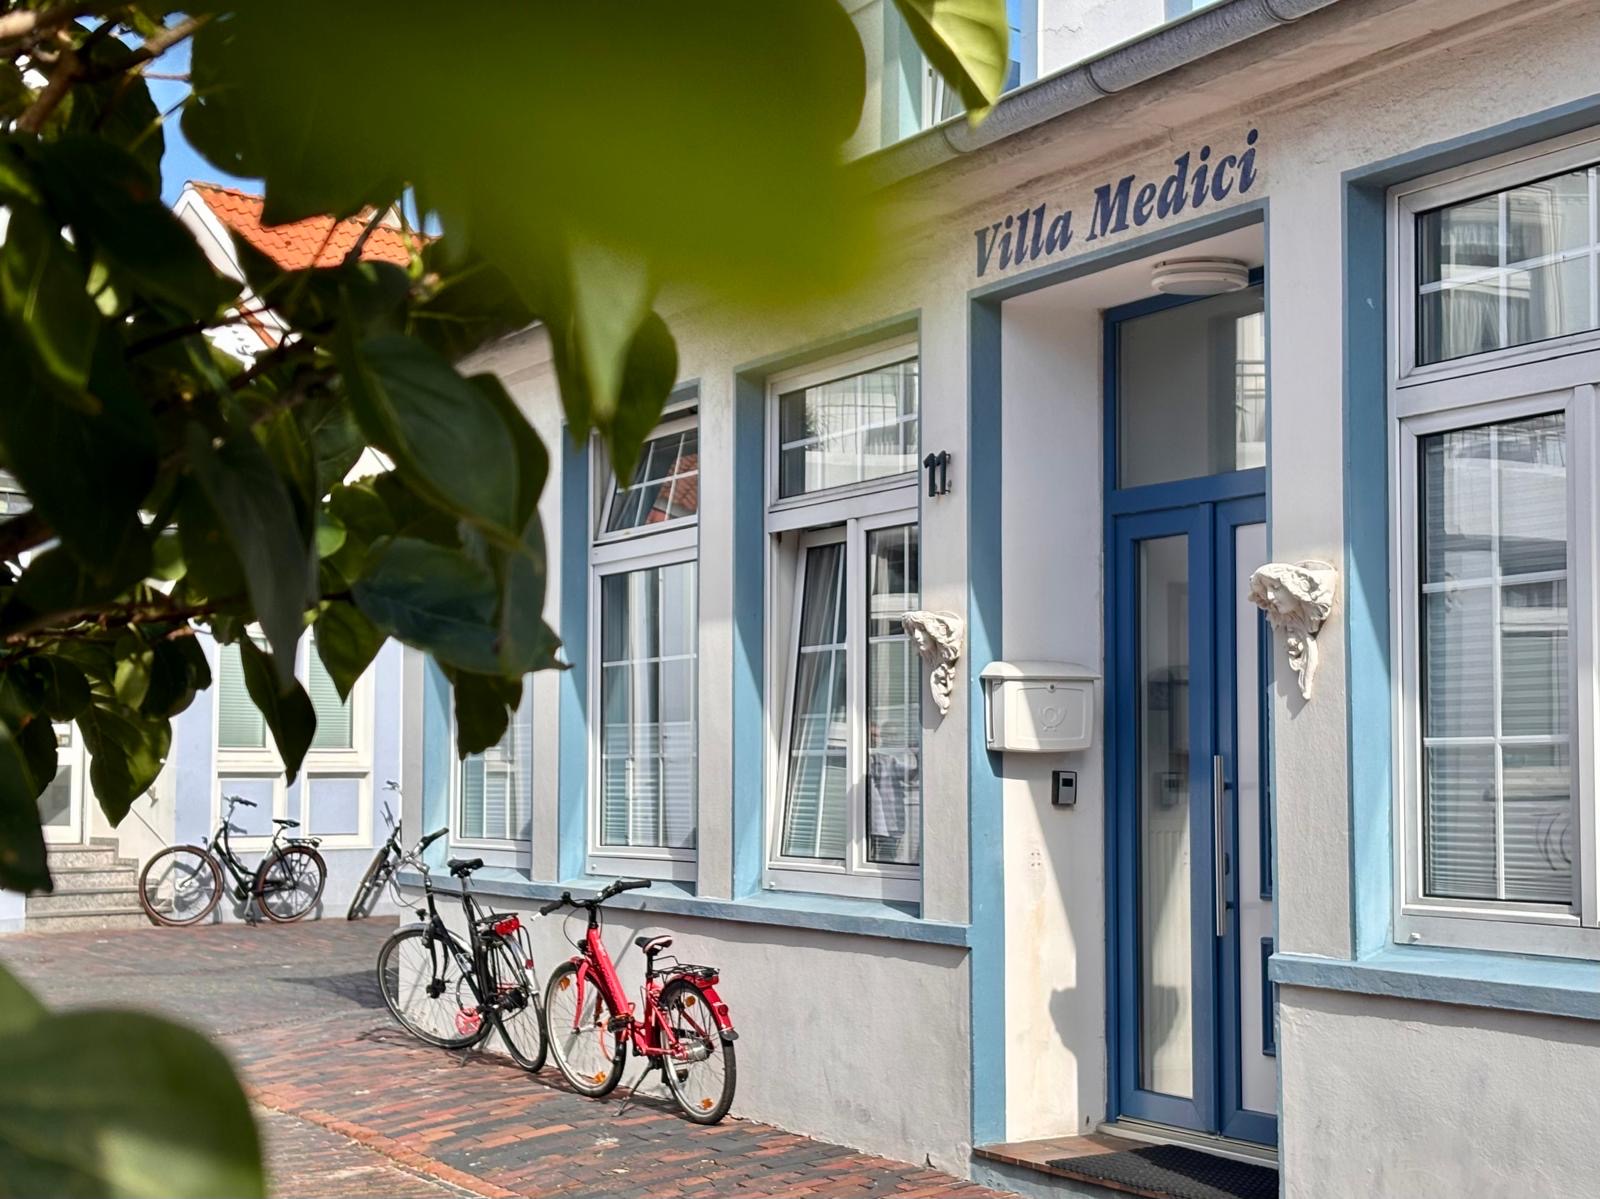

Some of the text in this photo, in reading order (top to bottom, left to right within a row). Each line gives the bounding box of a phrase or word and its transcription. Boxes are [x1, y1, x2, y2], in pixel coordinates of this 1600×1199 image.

[974, 129, 1258, 277] Villa Medici
[923, 450, 948, 497] 11
